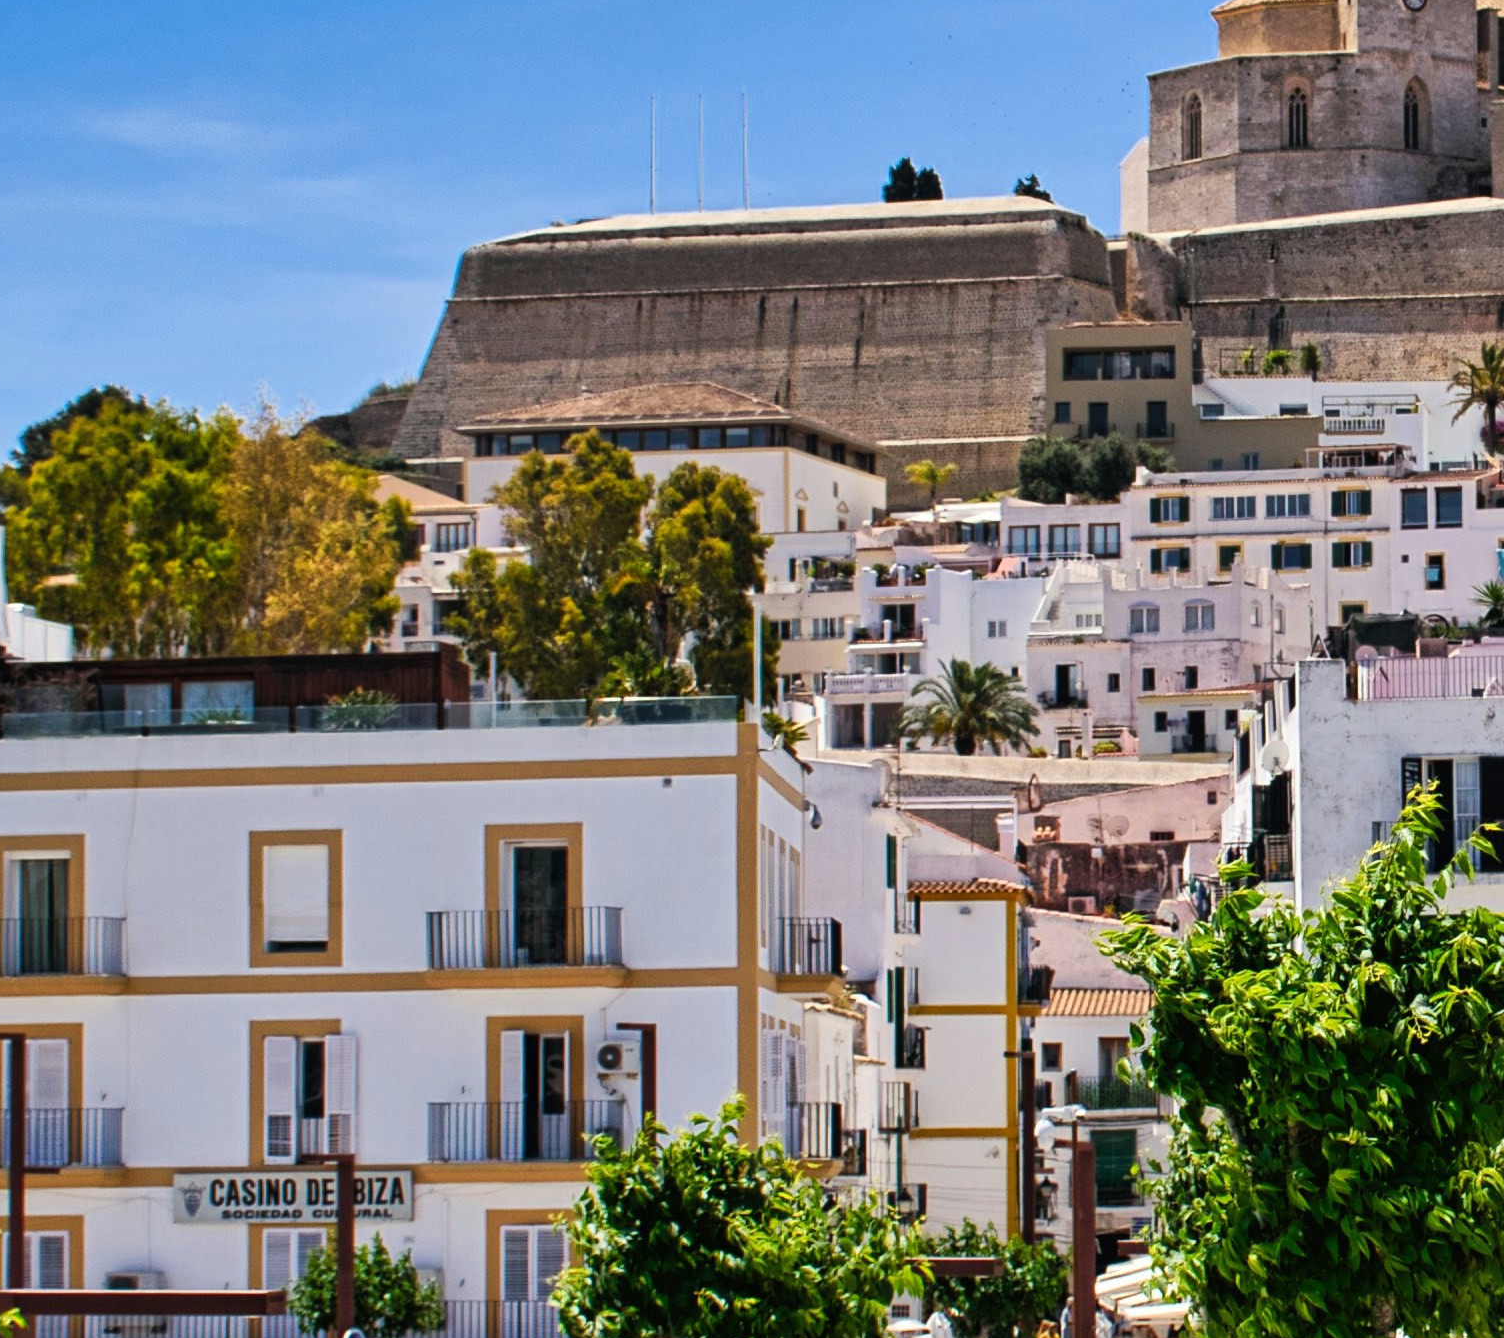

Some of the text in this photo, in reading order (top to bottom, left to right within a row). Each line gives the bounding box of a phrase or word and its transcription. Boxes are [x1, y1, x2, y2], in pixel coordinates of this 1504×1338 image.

[210, 1176, 405, 1207] CASINO DE BIZA
[222, 1208, 393, 1220] SOCIEDAD CUURAL
